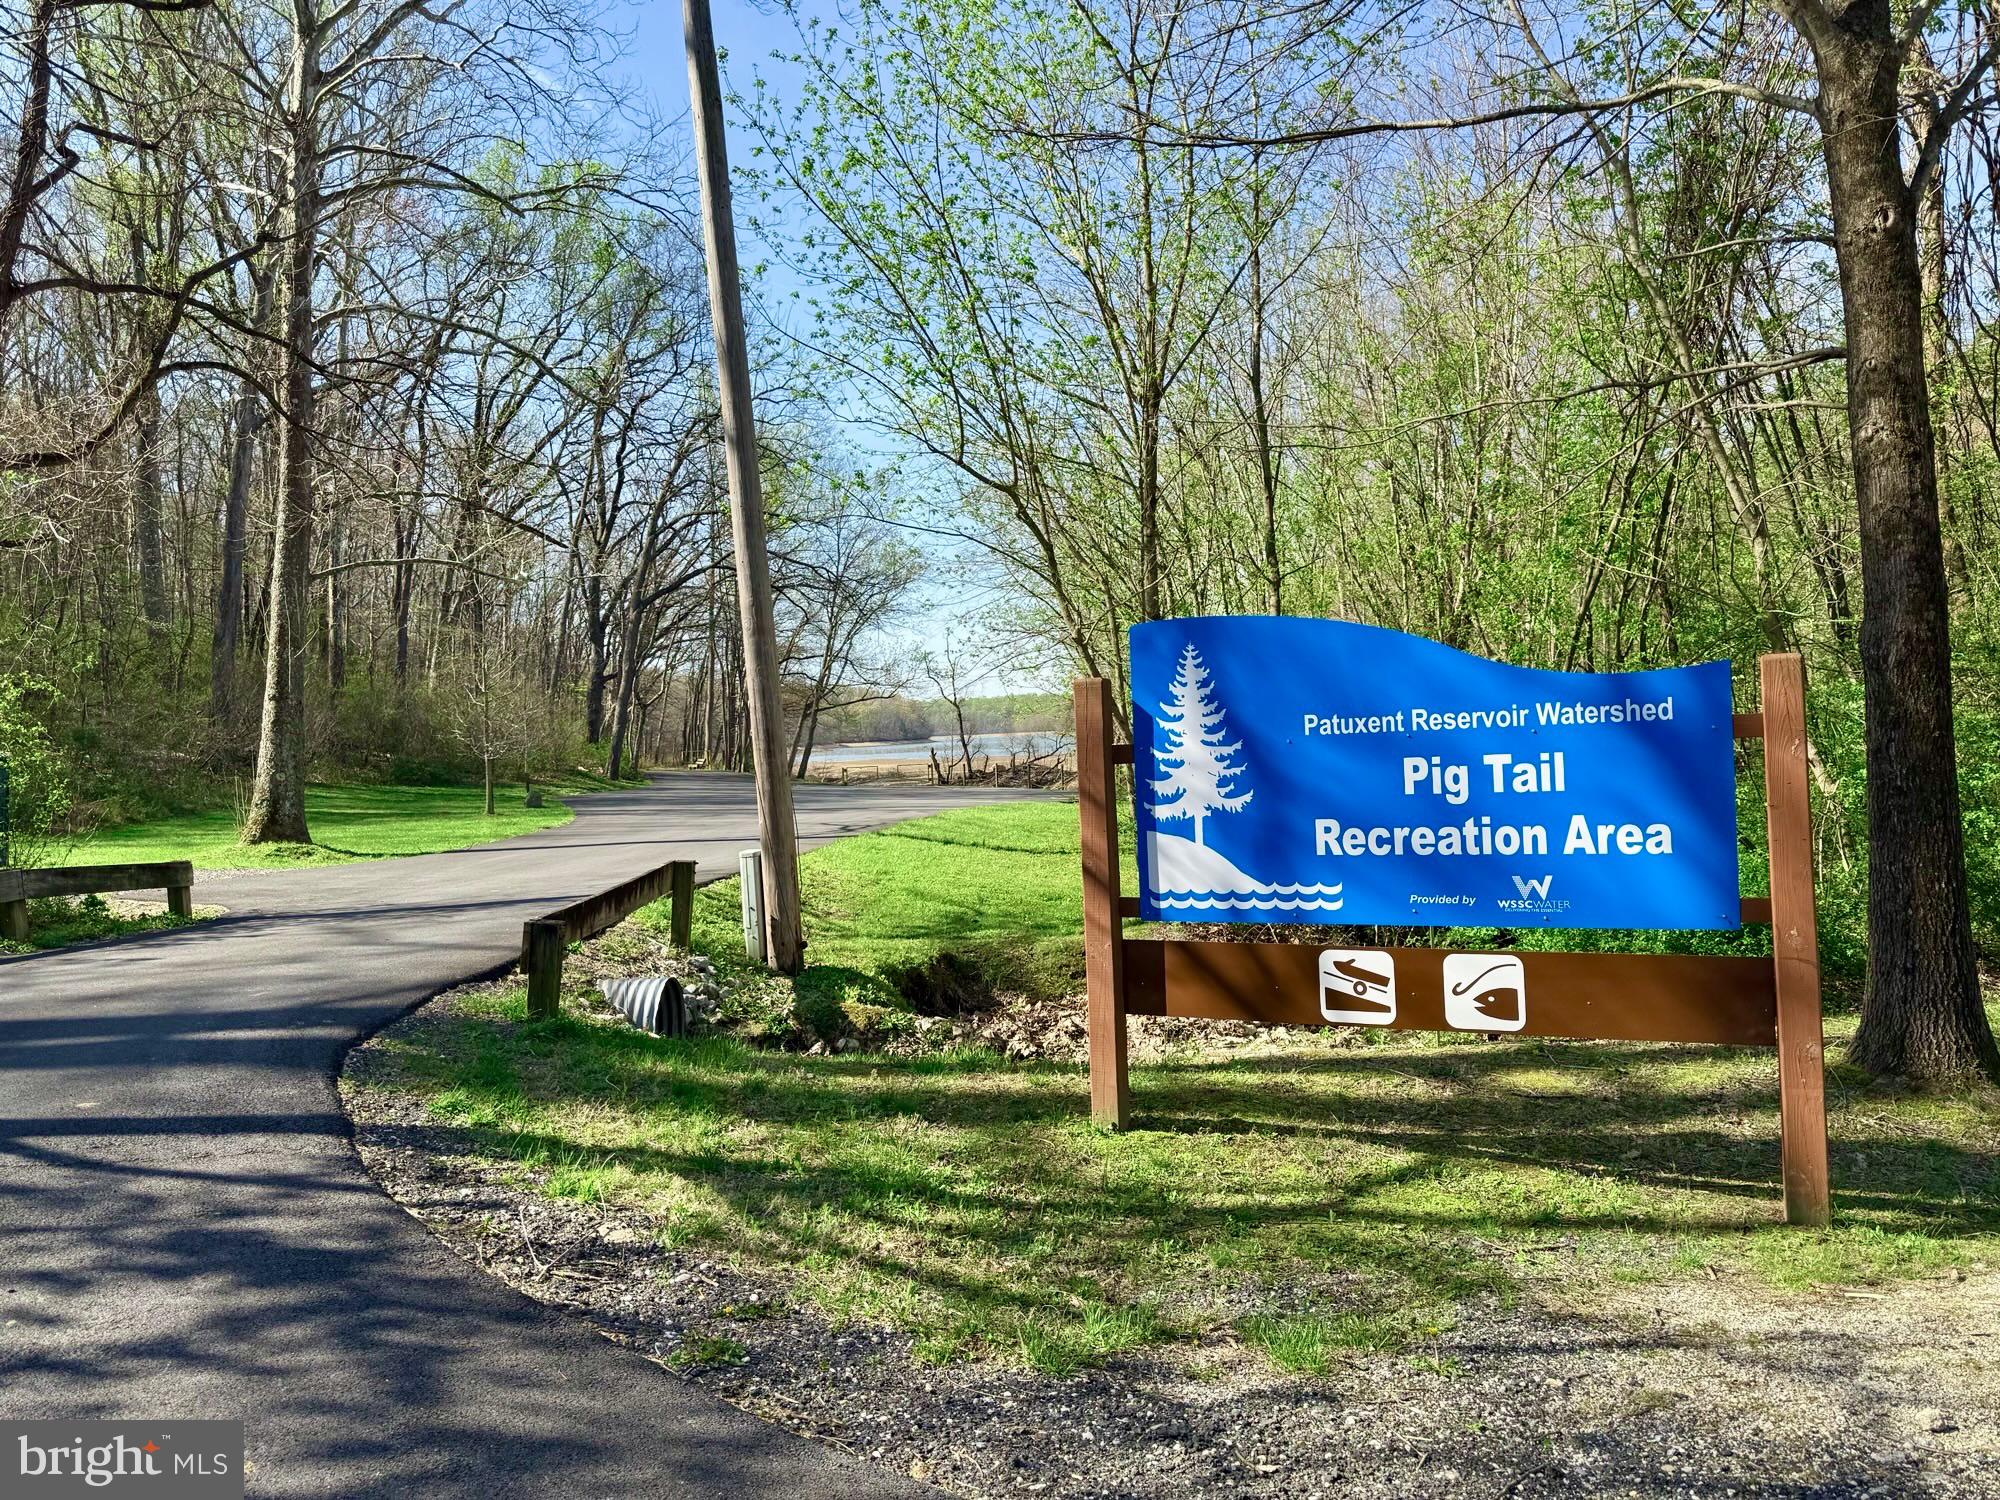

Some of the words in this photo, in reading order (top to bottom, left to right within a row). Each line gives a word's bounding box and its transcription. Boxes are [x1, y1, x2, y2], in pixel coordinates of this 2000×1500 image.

[1304, 711, 1405, 736] Patuxent
[1411, 704, 1530, 731] Reservoir
[1536, 696, 1674, 726] Watershed
[1402, 756, 1469, 805] Pig
[1483, 751, 1566, 793] Tail
[1314, 816, 1549, 857] Recreation
[1563, 814, 1674, 855] Area
[1409, 894, 1460, 904] Provided
[1462, 895, 1476, 906] by
